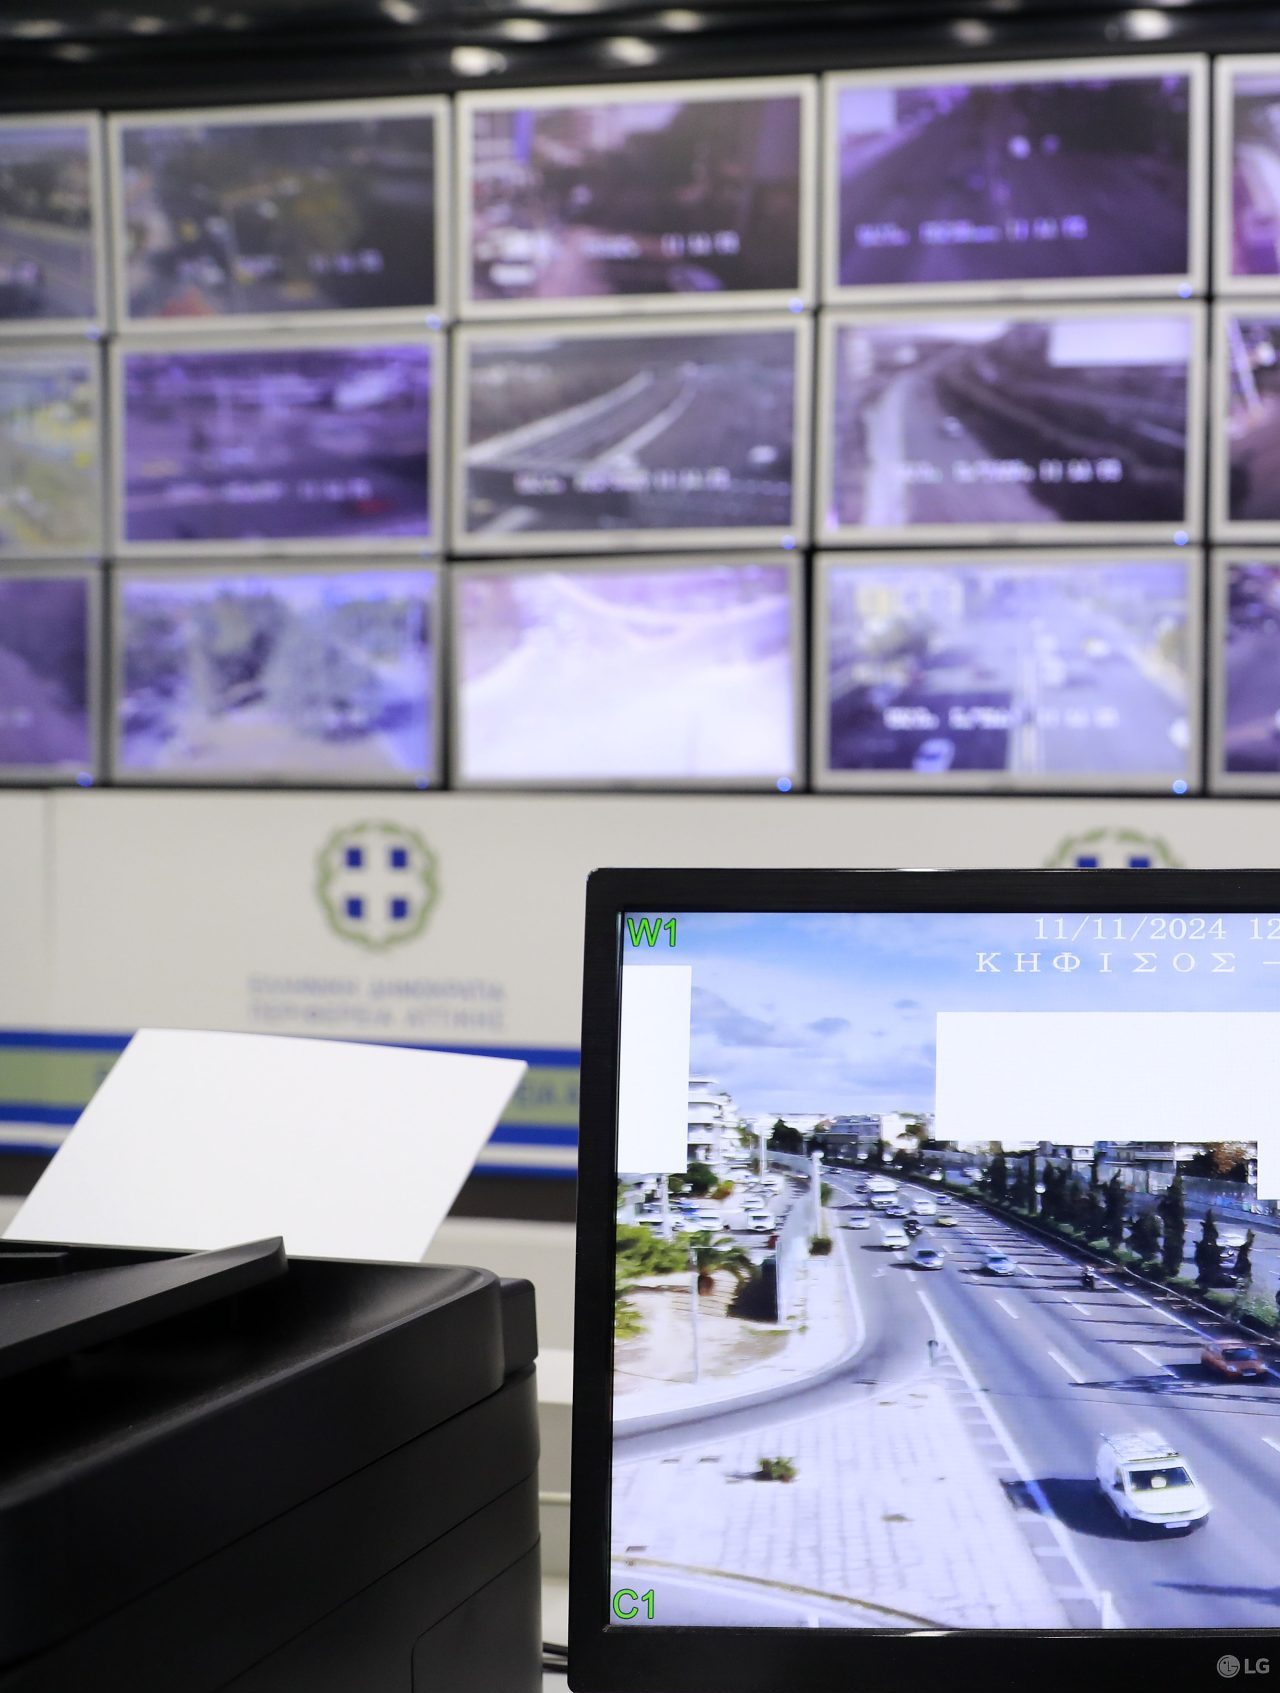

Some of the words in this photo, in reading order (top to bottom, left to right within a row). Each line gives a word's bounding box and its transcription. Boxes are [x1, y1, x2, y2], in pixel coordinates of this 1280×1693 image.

[626, 917, 677, 947] W1
[1033, 916, 1227, 942] 11/11/2024
[975, 952, 1236, 973] ΚΗΦΙΣΟΣ
[612, 1588, 655, 1620] C1
[1244, 1657, 1270, 1674] LG
